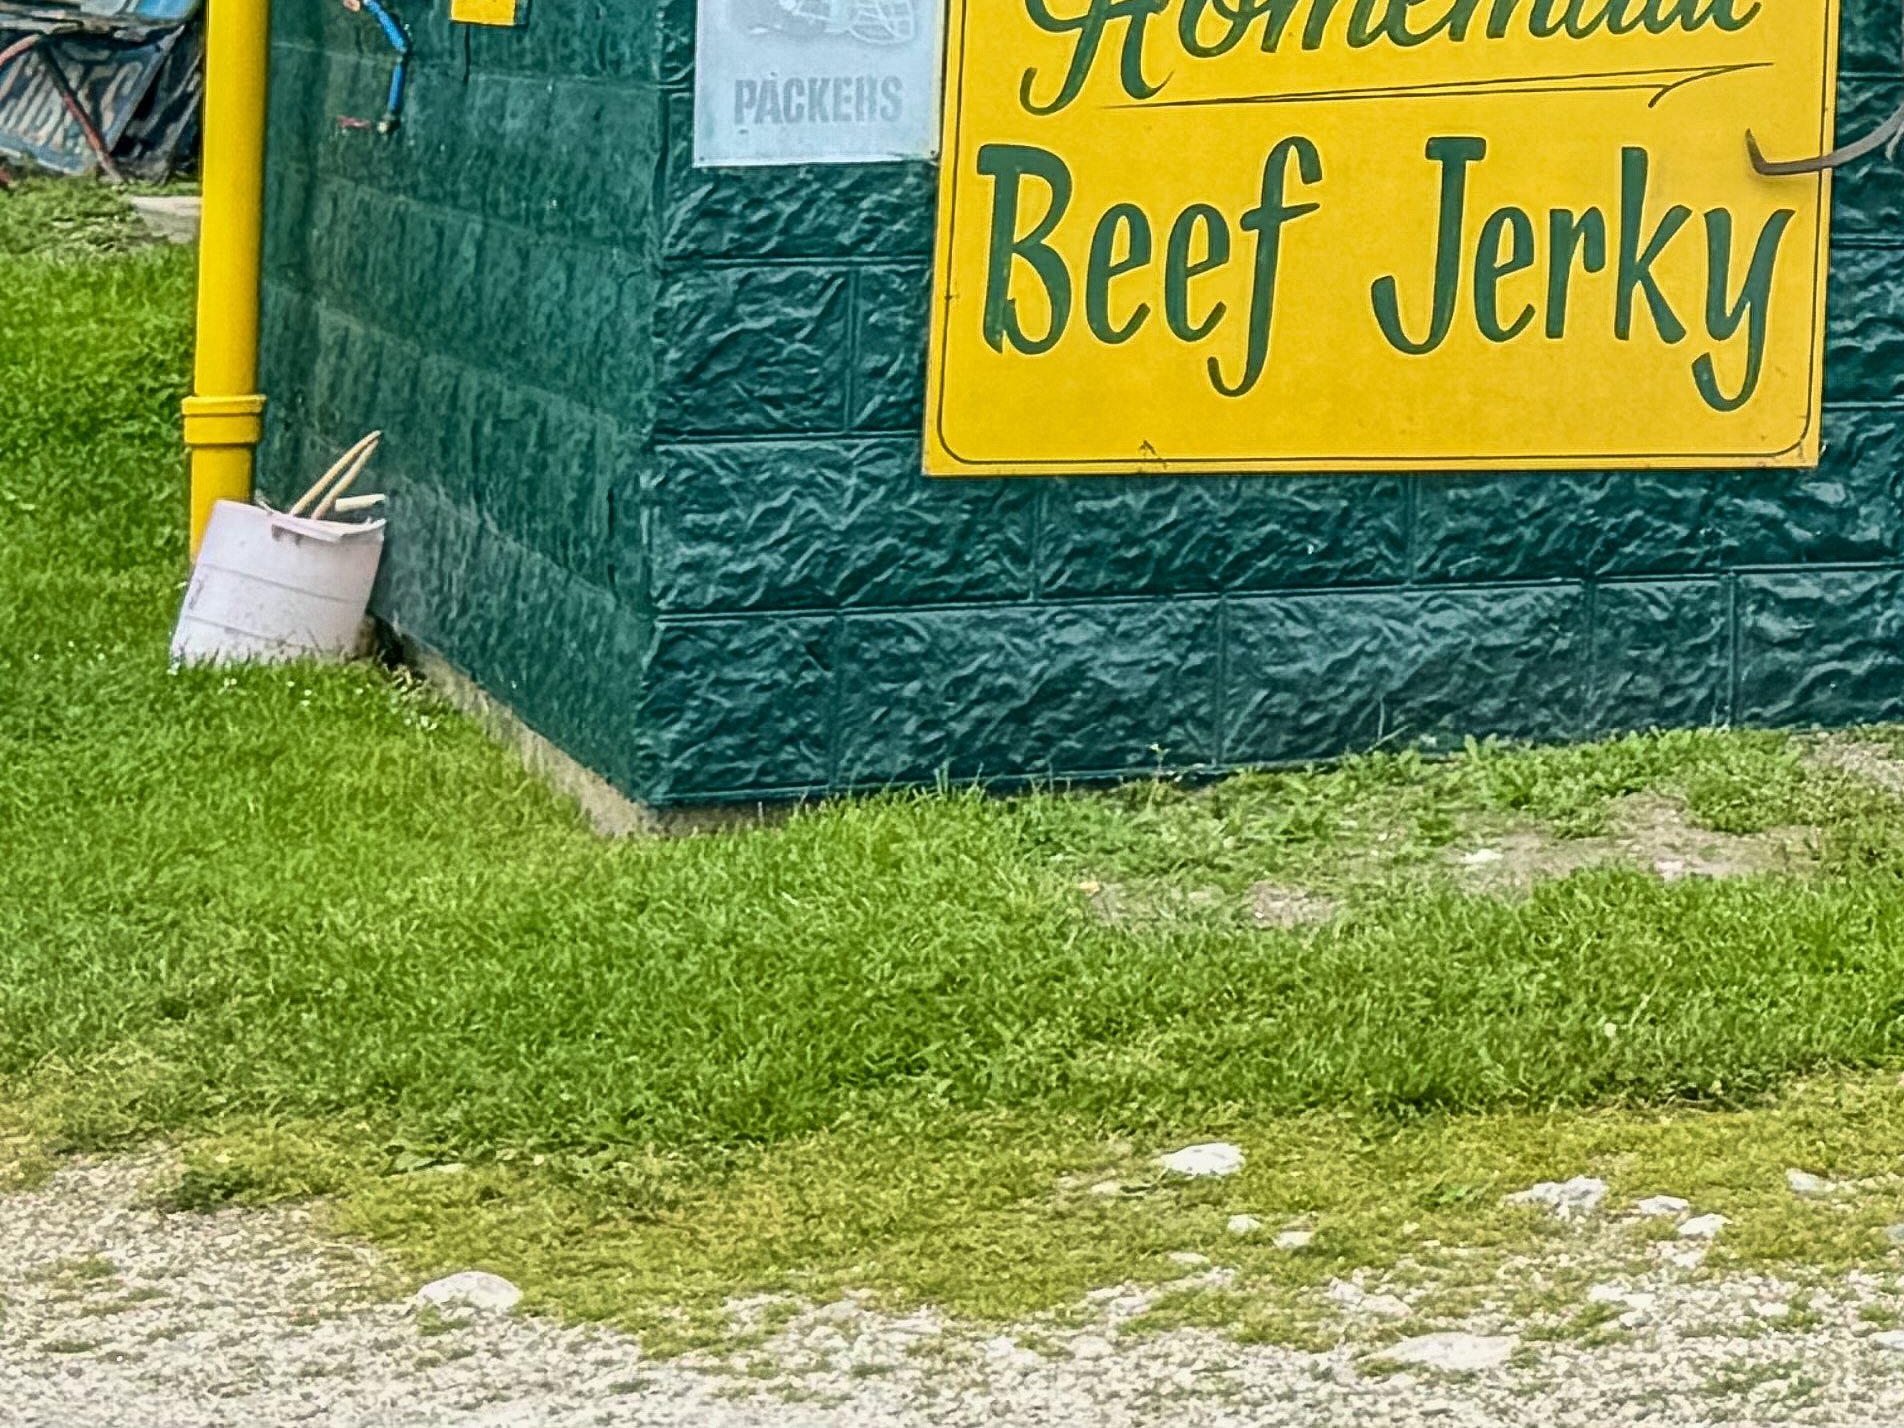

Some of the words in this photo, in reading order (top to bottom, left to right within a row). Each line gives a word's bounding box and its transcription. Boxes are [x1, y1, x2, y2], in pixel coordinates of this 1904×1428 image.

[733, 75, 905, 125] PACKERS
[976, 134, 1323, 398] Beef
[1370, 134, 1796, 412] Jerky
